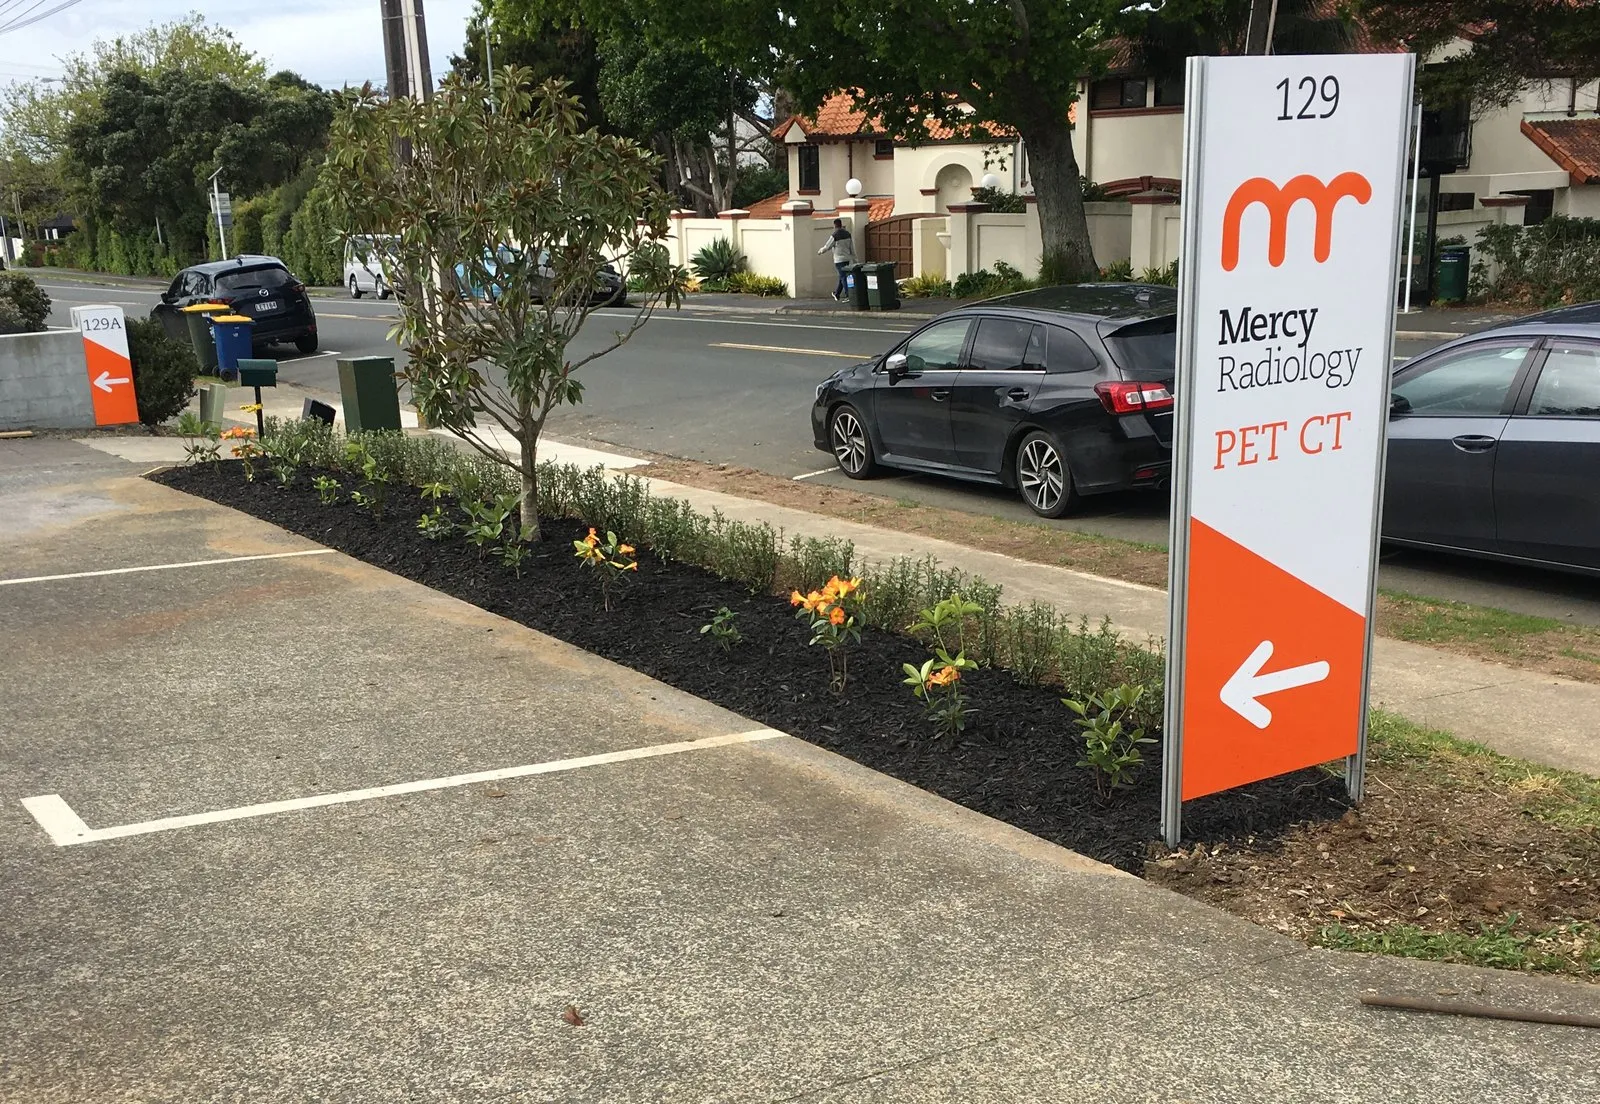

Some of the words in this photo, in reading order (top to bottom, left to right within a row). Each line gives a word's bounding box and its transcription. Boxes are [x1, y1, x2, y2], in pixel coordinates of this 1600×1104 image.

[1276, 75, 1340, 121] 129
[83, 317, 122, 331] 129A
[1218, 306, 1319, 346] Mercy
[1217, 344, 1364, 393] Radiology
[1214, 421, 1288, 470] PET
[1299, 411, 1352, 455] CT
